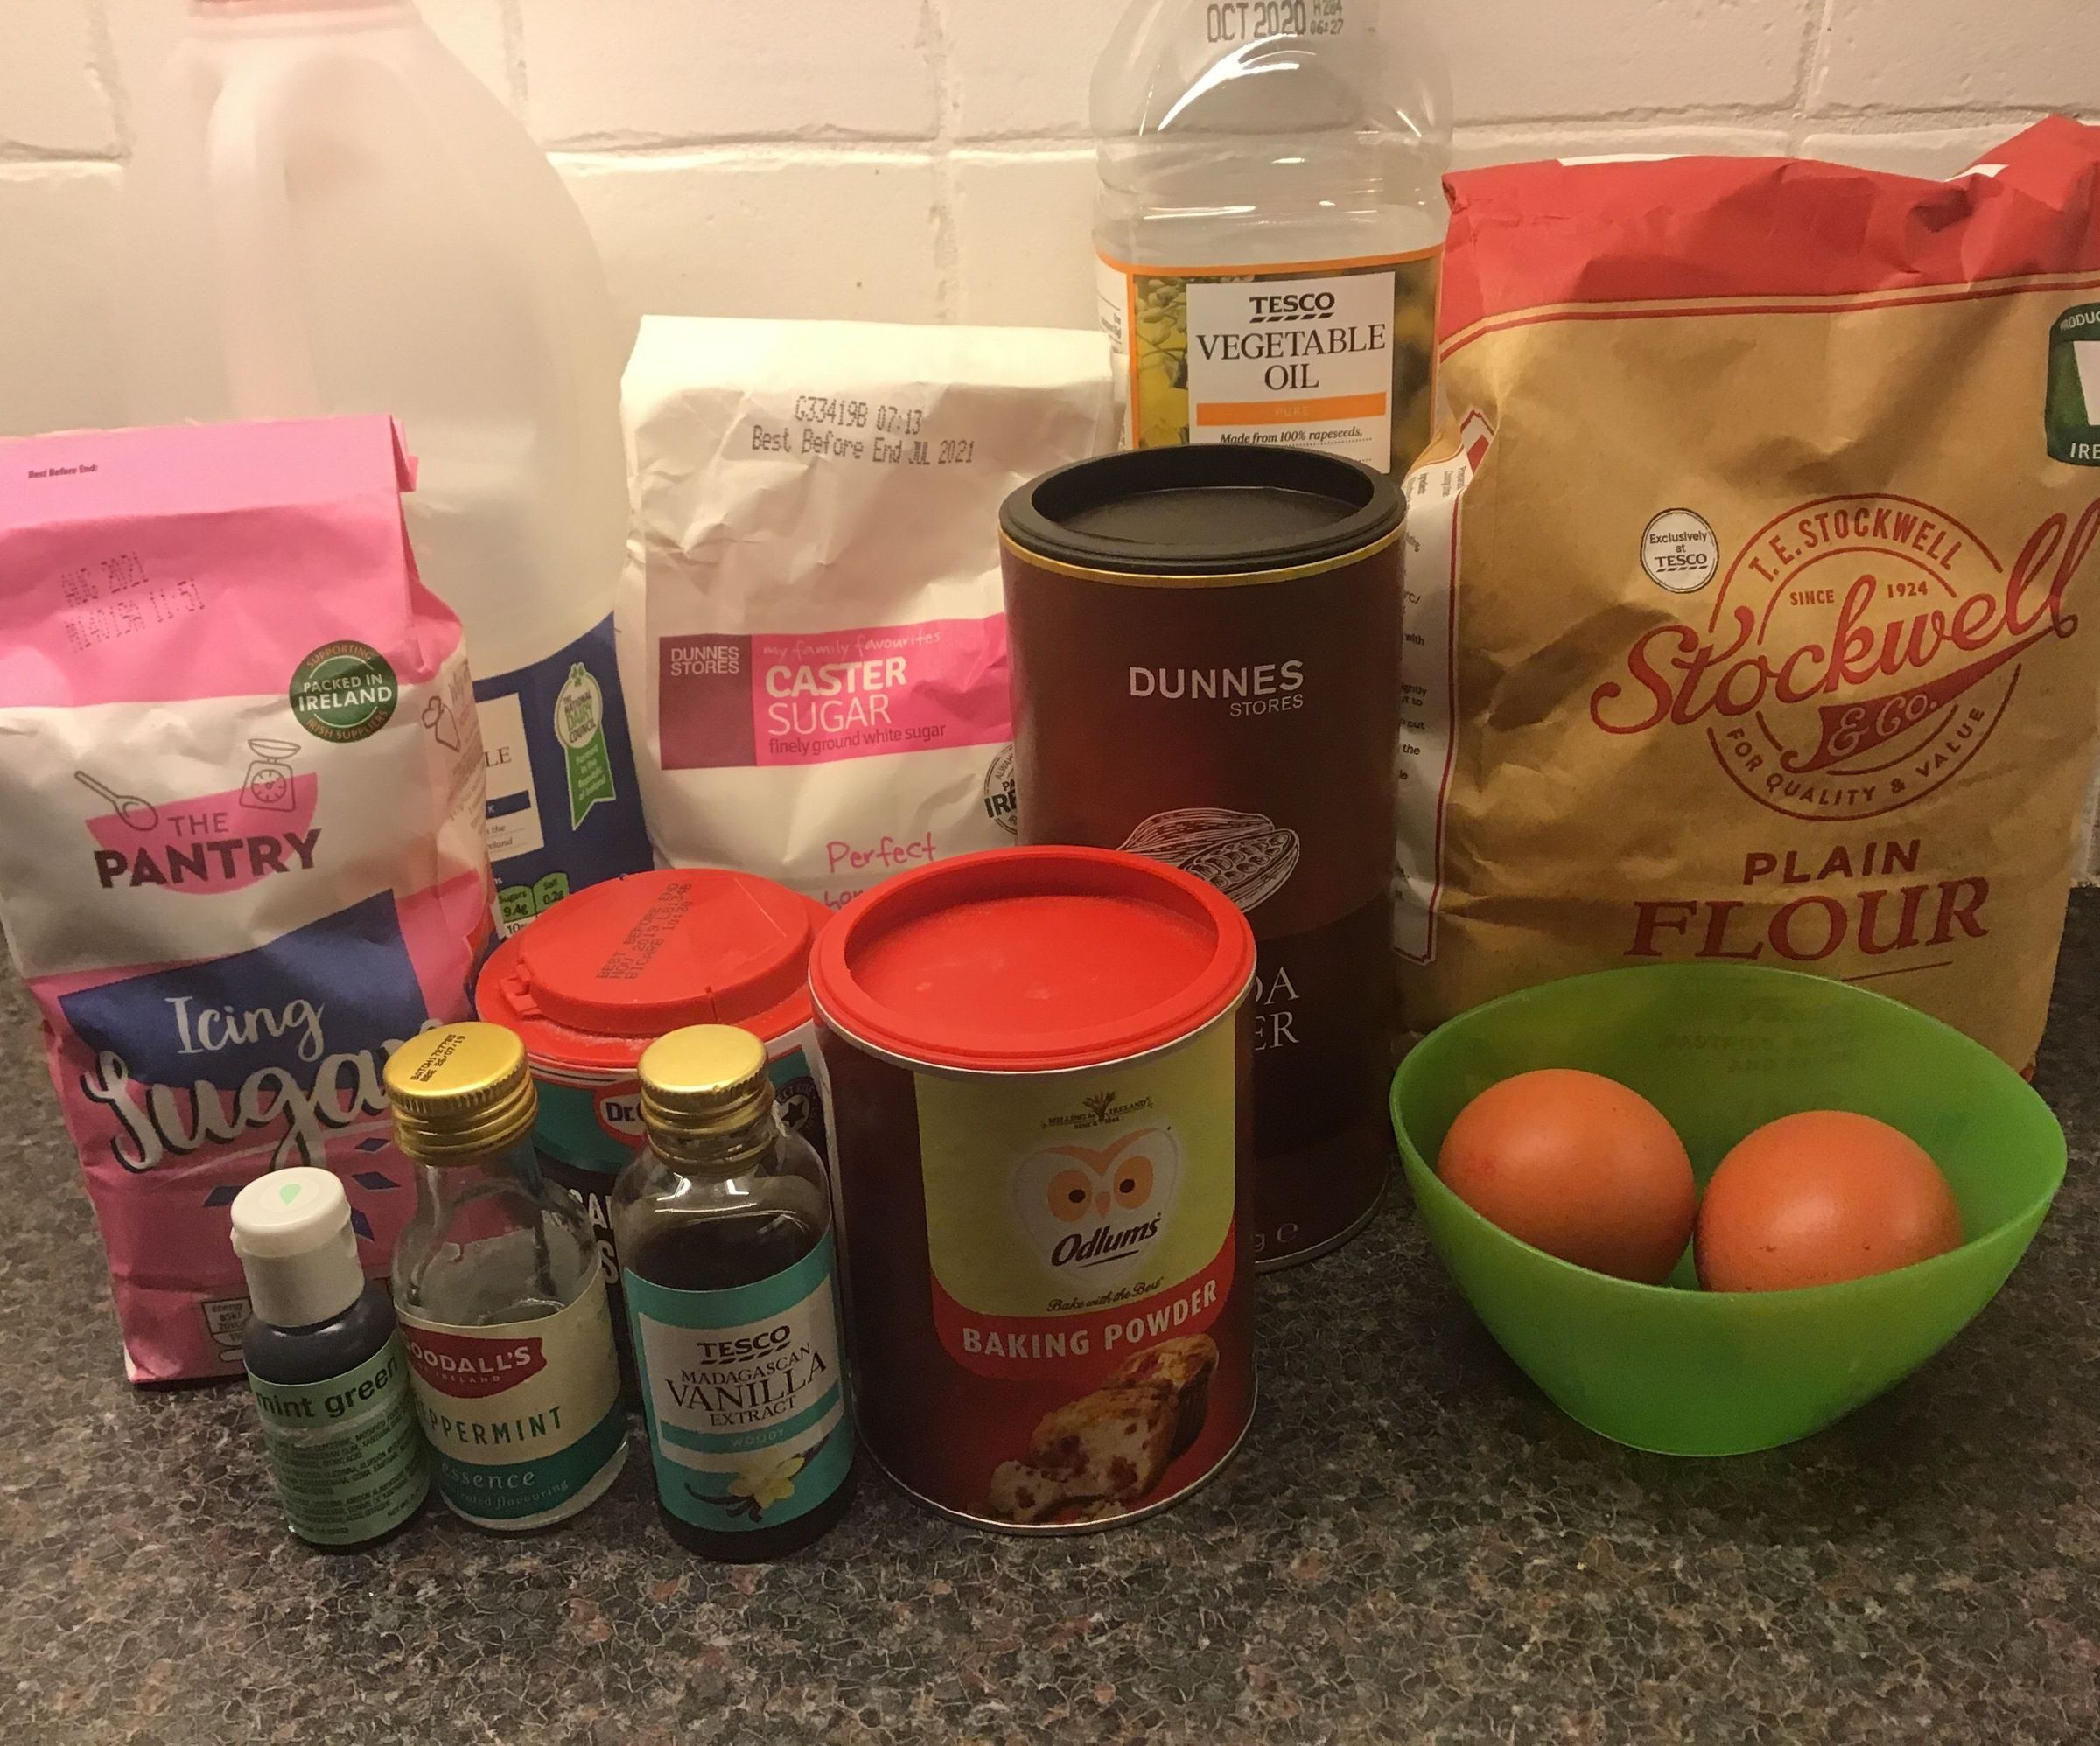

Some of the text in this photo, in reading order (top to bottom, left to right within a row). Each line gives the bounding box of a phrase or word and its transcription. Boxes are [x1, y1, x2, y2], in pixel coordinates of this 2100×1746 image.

[1207, 0, 1306, 42] OCT 2020
[1249, 292, 1335, 315] TESCO
[1196, 323, 1386, 361] VEGETABLE
[1264, 363, 1320, 390] OIL
[876, 405, 923, 435] 07:13
[1221, 426, 1362, 444] Made from 100% rapeseeds,
[752, 424, 975, 464] Best Before End JUL 2021
[28, 469, 46, 478] Best
[1649, 530, 1708, 546] Exclusively
[1676, 543, 1686, 554] at
[1654, 553, 1708, 568] TESCO
[1789, 580, 1928, 606] SINCE 1924
[1590, 497, 2100, 735] Stockwell
[671, 646, 740, 662] DUNNES
[854, 630, 942, 656] favourites
[303, 674, 382, 693] PACKED IN
[671, 660, 740, 676] STORES
[765, 656, 907, 697] CASTER
[1129, 660, 1304, 701] DUNNES
[298, 687, 393, 712] IRELAND
[768, 694, 892, 736] SUGAR
[1229, 695, 1304, 718] STORES
[768, 723, 947, 756] finely ground white sugar
[1403, 744, 1420, 755] the
[1726, 706, 1985, 806] FOR QUALITY & VALUE
[168, 812, 229, 838] THE
[93, 827, 324, 889] PANTRY
[826, 831, 936, 874] Perfect
[1743, 839, 1921, 885] PLAIN
[1623, 876, 1989, 960] FLOUR
[164, 995, 326, 1062] Icing
[1052, 1217, 1162, 1267] Odlums
[963, 1279, 1217, 1359] BAKING POWDER
[1047, 1297, 1084, 1312] Bake
[697, 1325, 791, 1358] TESCO
[681, 1342, 812, 1385] MADAGASCAN
[256, 1357, 398, 1419] mint green
[664, 1351, 827, 1412] VANILLA
[710, 1395, 797, 1427] EXTRACT
[442, 1463, 536, 1488] essence
